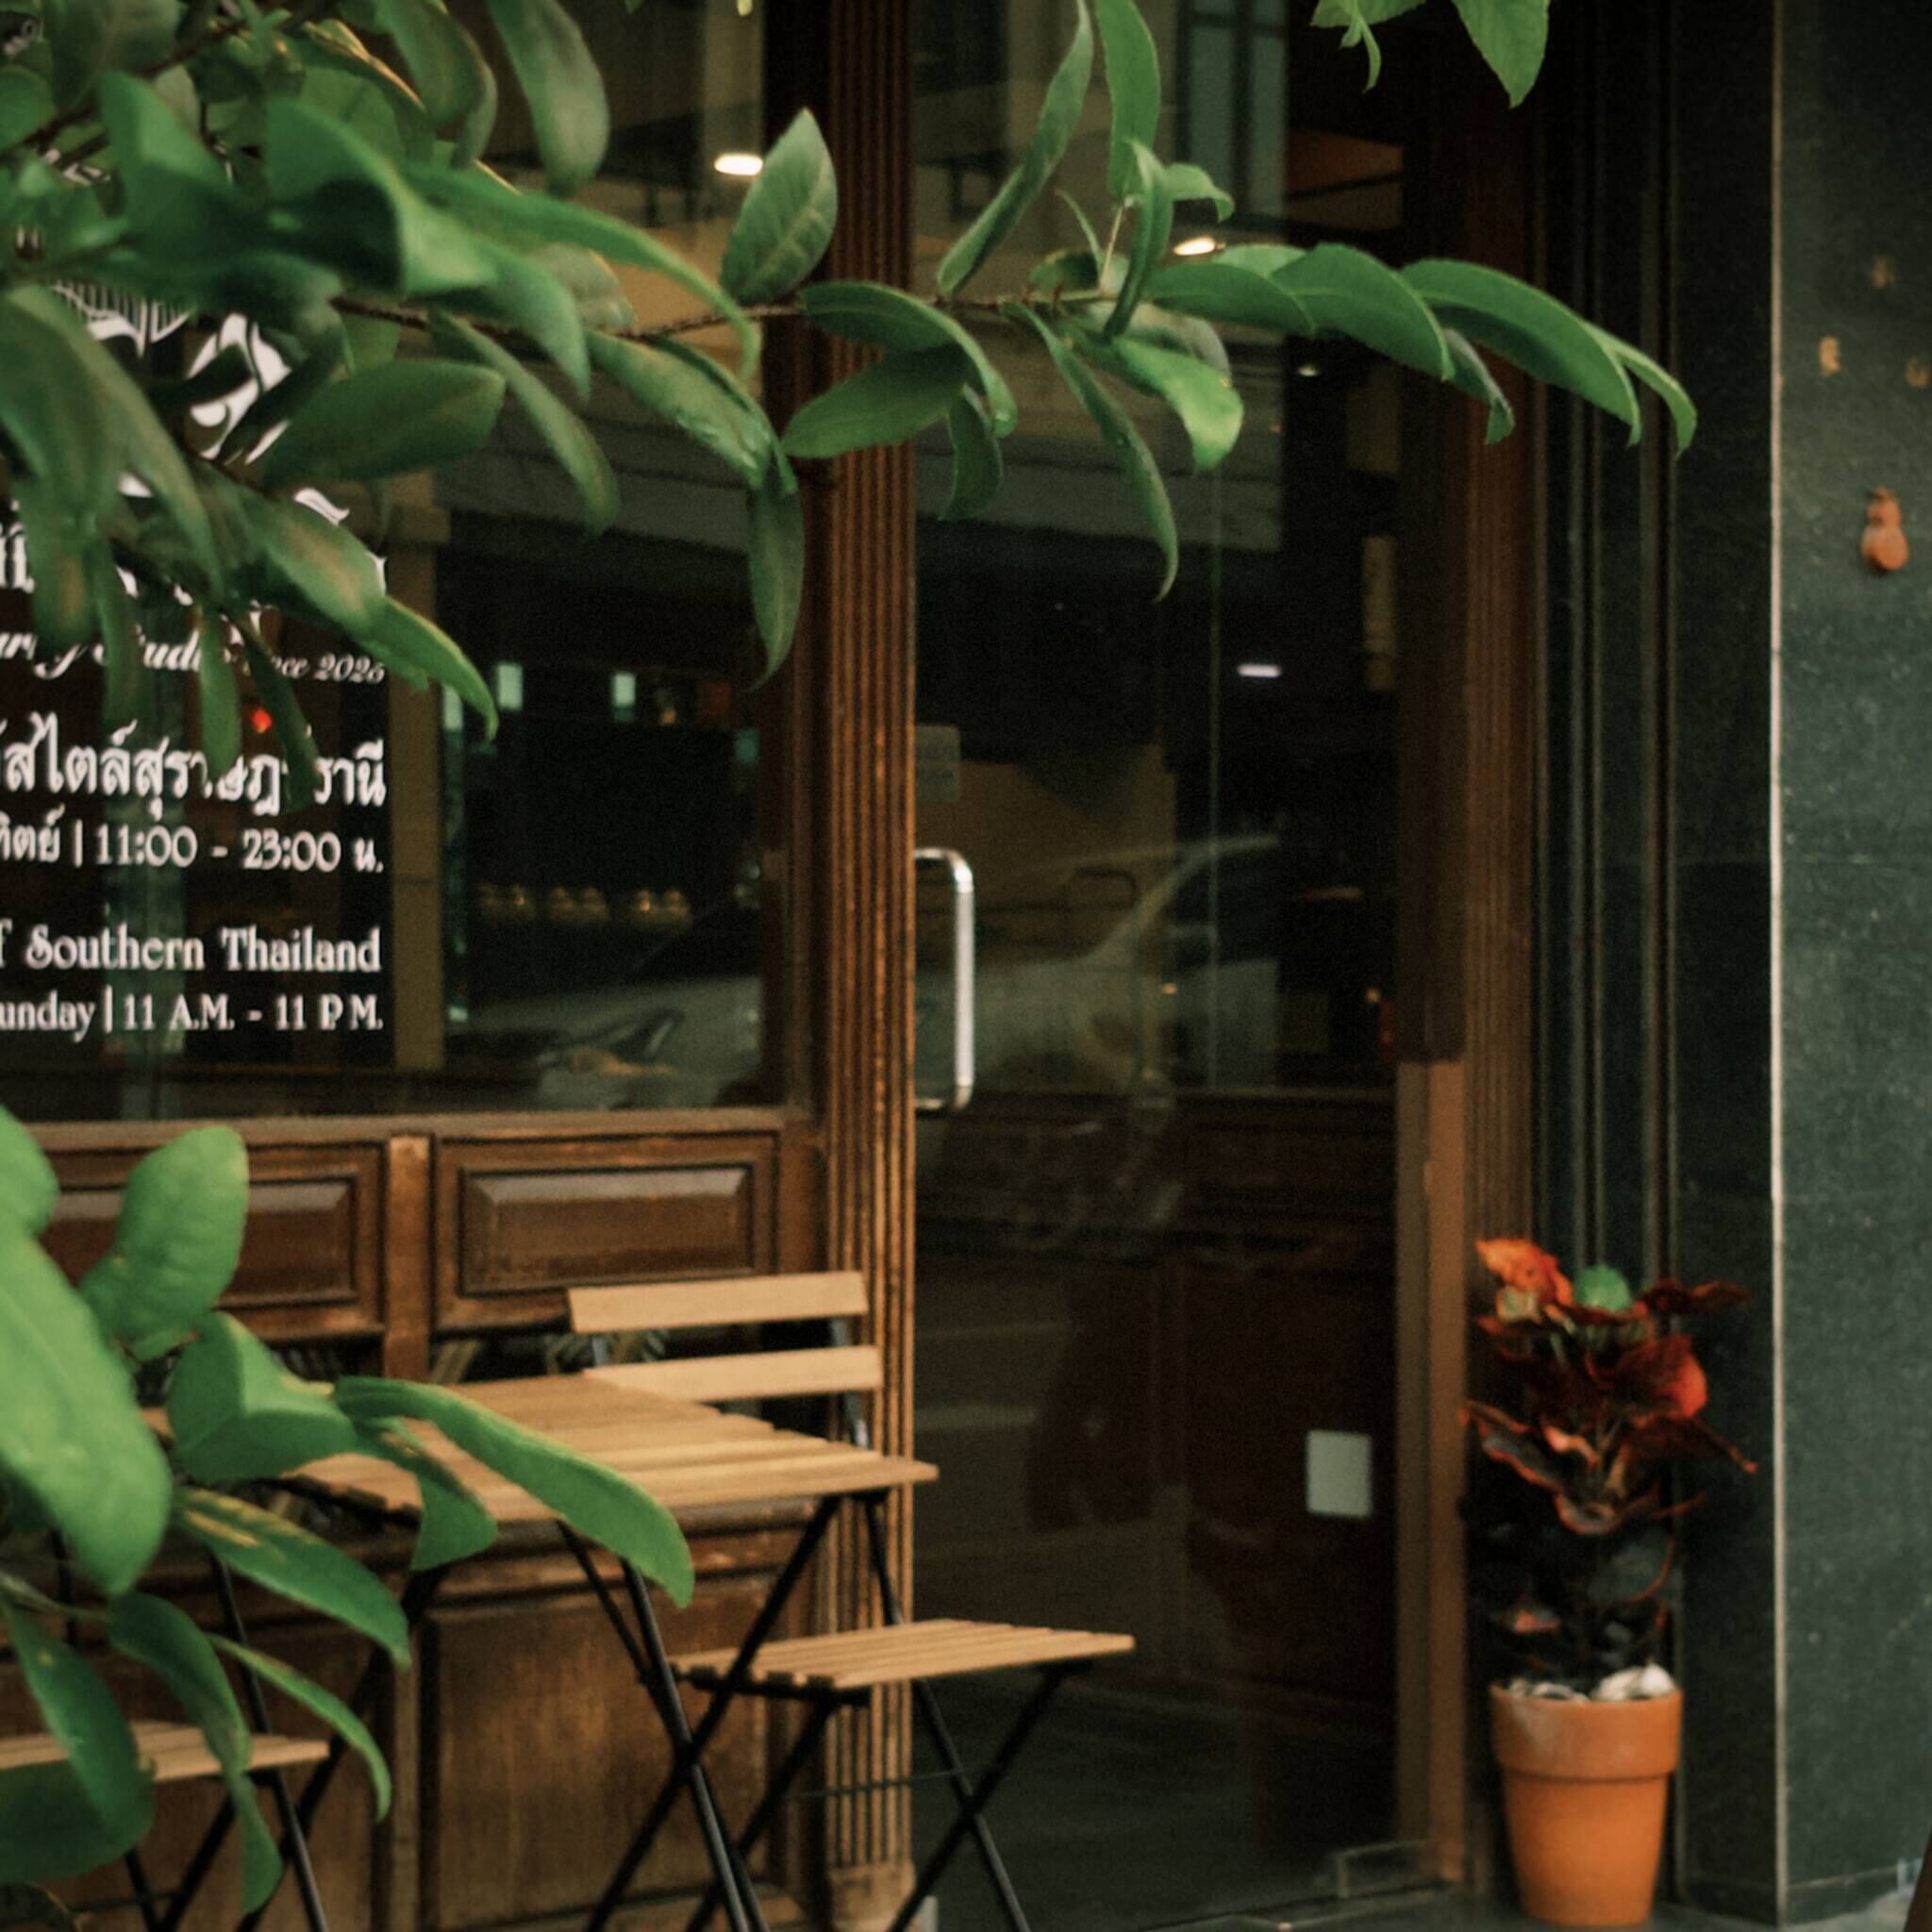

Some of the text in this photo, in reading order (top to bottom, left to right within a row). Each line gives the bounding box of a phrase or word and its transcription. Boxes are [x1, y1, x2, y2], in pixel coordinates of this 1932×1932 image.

[97, 824, 198, 868] 11:00
[242, 828, 341, 872] 23:00
[25, 923, 205, 971] Southern
[220, 924, 381, 973] Thailand
[0, 991, 95, 1042] unday
[125, 993, 155, 1030] 11
[276, 994, 306, 1030] 11
